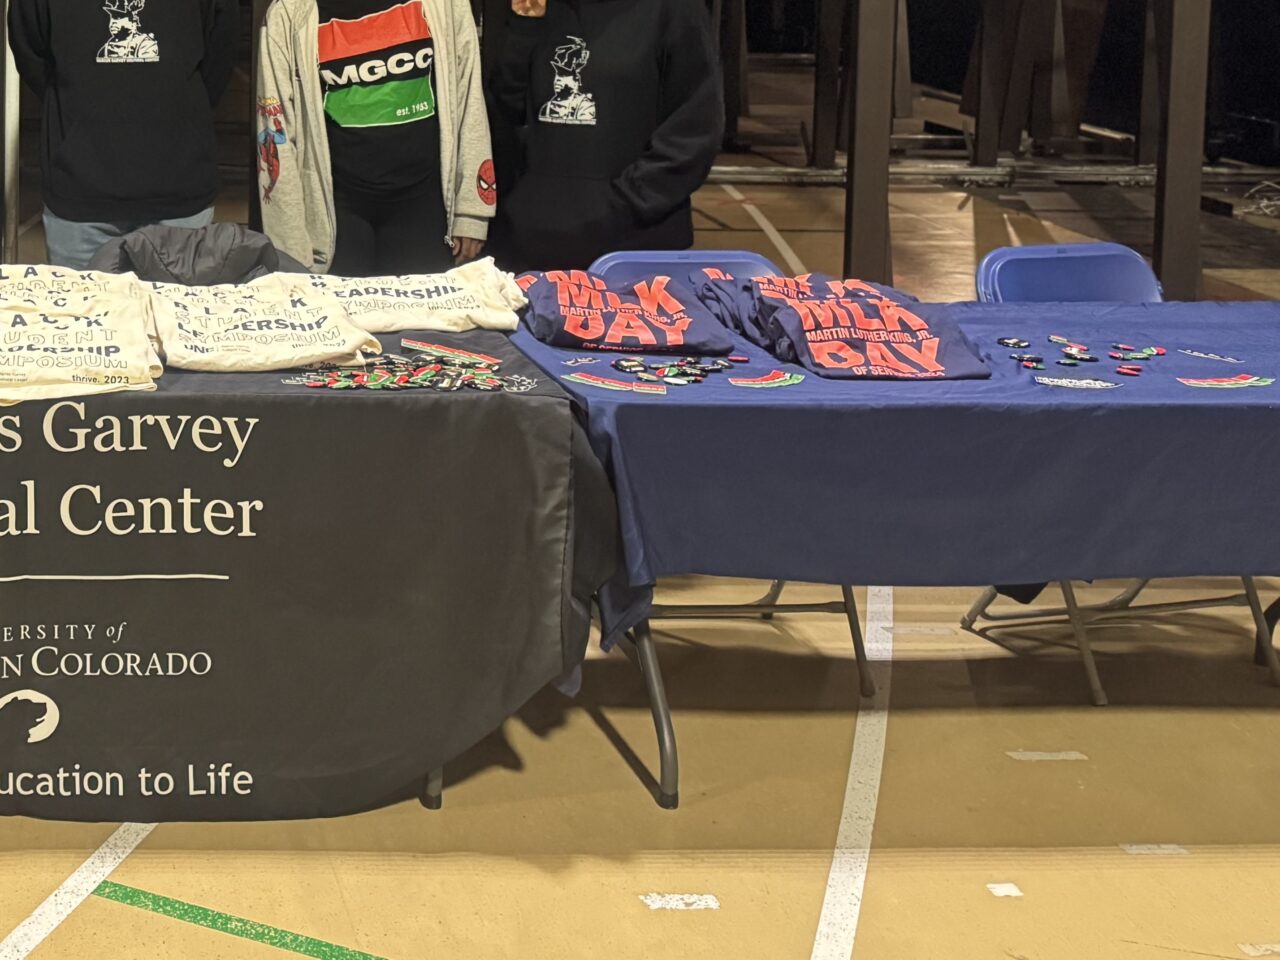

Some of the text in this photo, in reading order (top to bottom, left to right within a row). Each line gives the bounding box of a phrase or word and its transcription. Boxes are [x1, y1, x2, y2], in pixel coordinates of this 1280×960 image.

[321, 48, 433, 85] MGCC
[396, 105, 411, 116] est.
[560, 306, 601, 317] MARTIN
[787, 299, 929, 332] MLK
[806, 329, 933, 344] MARTIN LUTHER KING, JR.
[808, 338, 945, 373] DAY
[852, 366, 868, 375] OF
[72, 374, 100, 383] thrive.
[104, 375, 130, 384] 2023
[43, 400, 260, 468] Garvey
[59, 483, 264, 537] Center
[106, 621, 127, 644] of
[31, 645, 213, 677] COLORADO
[138, 766, 175, 796] to
[187, 762, 254, 796] Life
